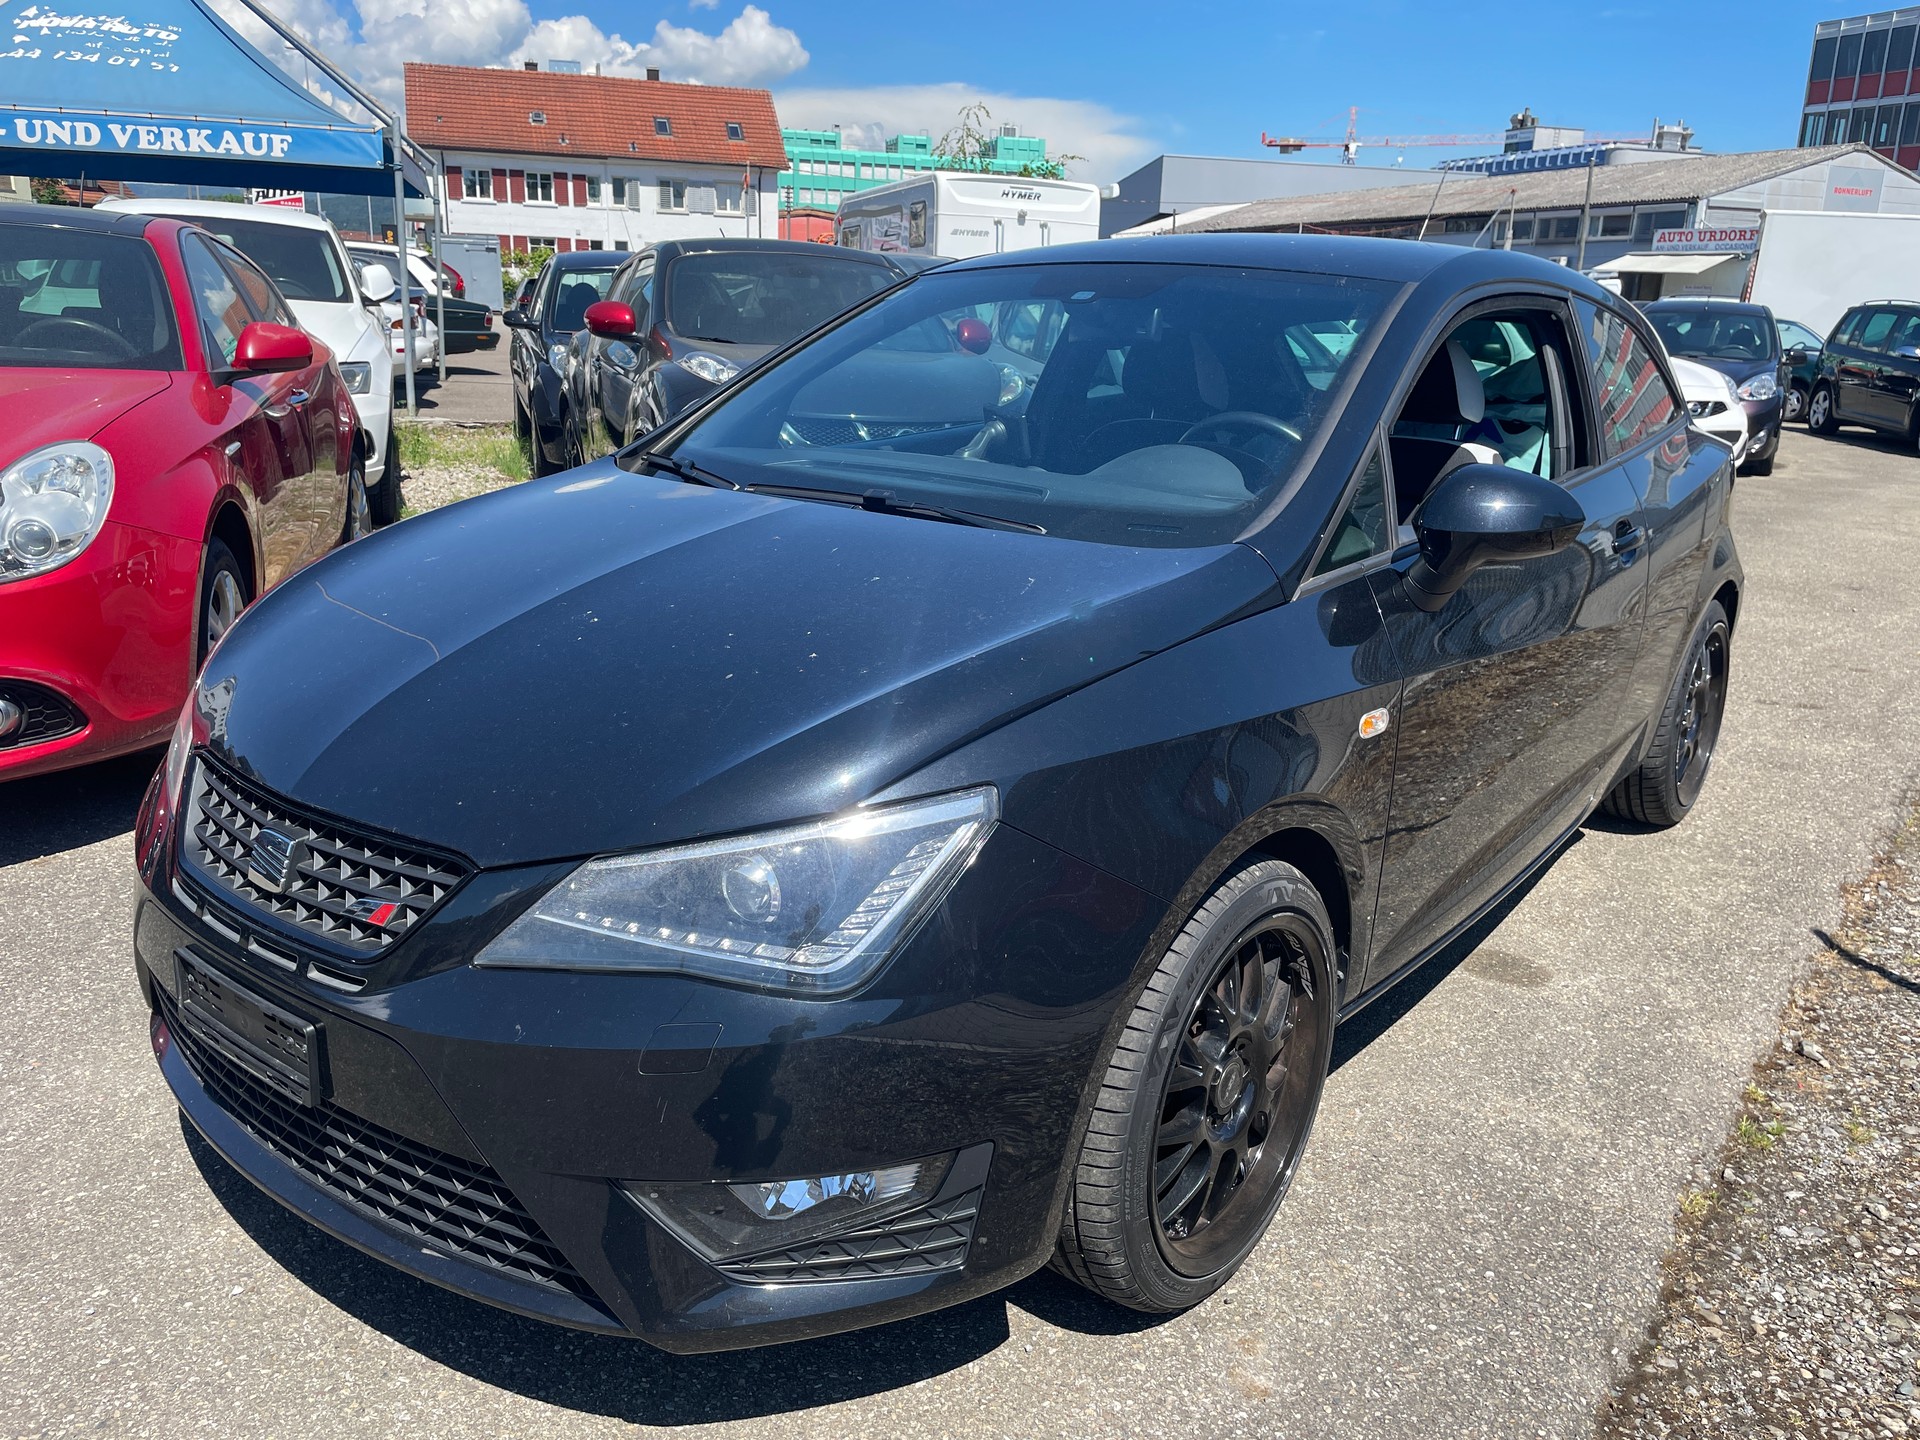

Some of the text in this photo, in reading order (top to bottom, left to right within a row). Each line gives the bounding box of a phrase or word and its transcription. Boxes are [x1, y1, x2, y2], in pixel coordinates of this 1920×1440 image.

[14, 118, 293, 158] UND VERKAUF
[1001, 189, 1042, 201] HYMER
[958, 228, 990, 238] HYMER
[1656, 229, 1760, 243] AUTO URDORF
